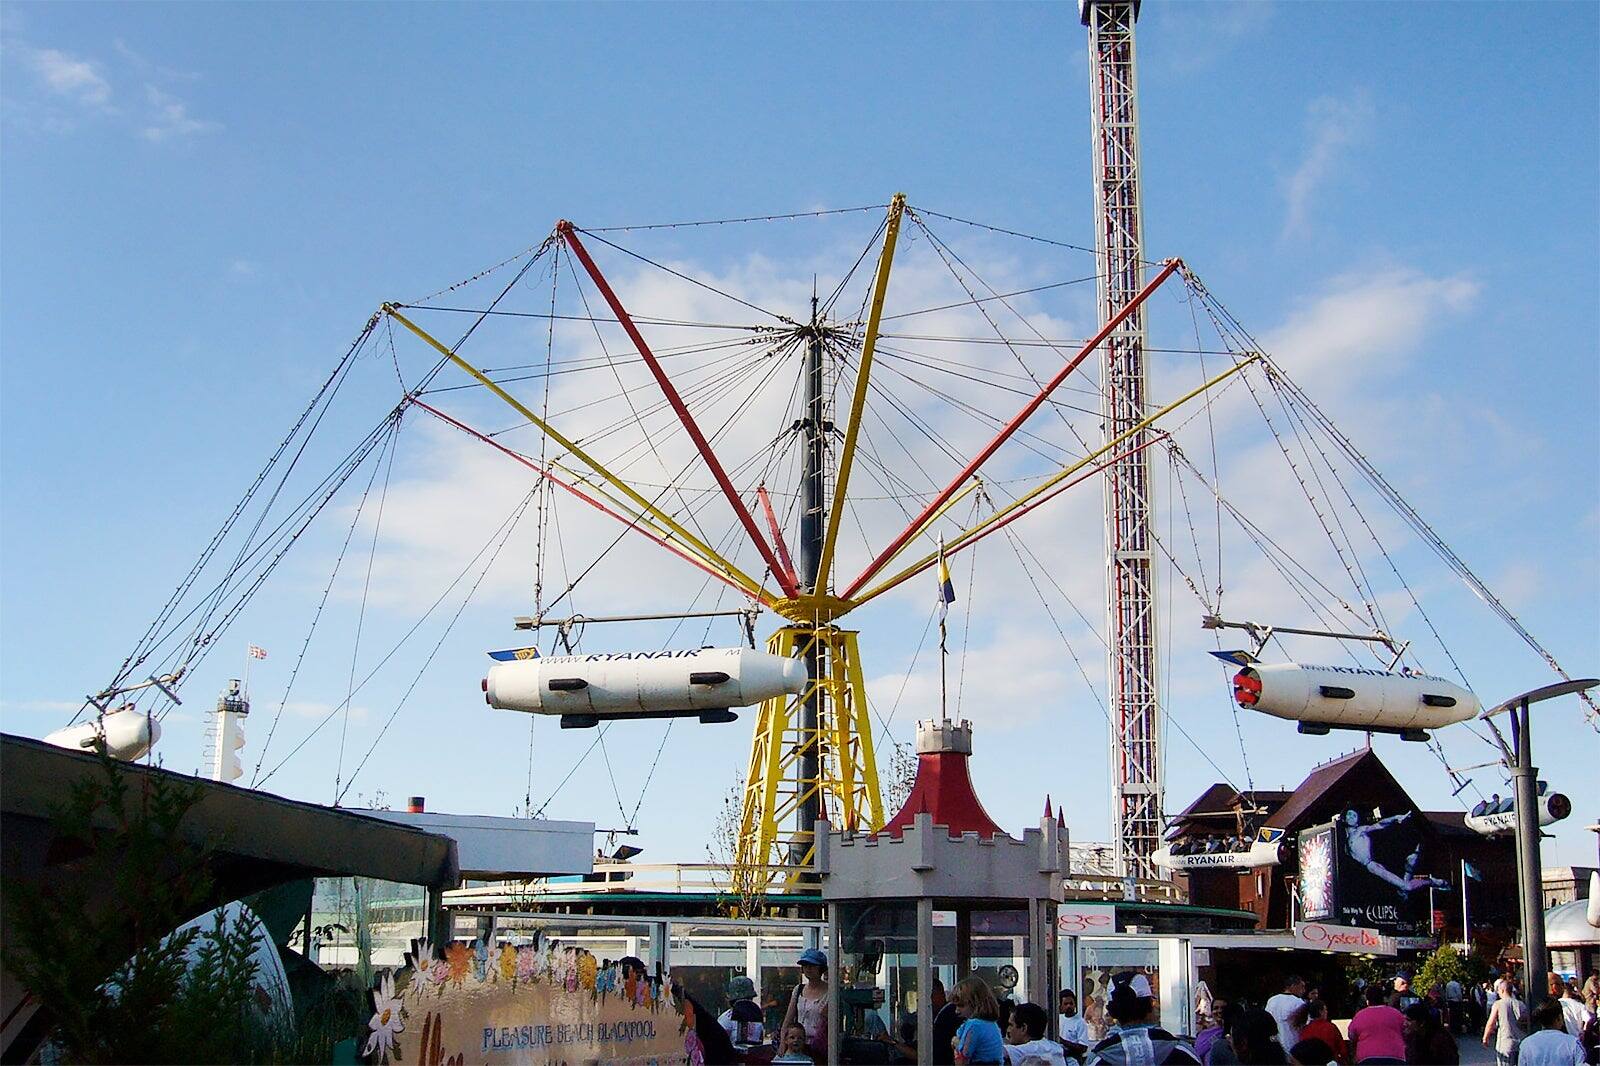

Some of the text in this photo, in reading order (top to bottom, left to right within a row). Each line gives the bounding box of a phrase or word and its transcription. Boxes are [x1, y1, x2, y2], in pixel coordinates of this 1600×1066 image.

[585, 649, 702, 662] RYANAIR
[1187, 855, 1234, 865] RYANAIR
[1366, 905, 1398, 921] ECLIPSE
[1302, 924, 1360, 949] Oyster
[484, 1021, 656, 1048] PLEASURE BEACH BLACKPOOL
